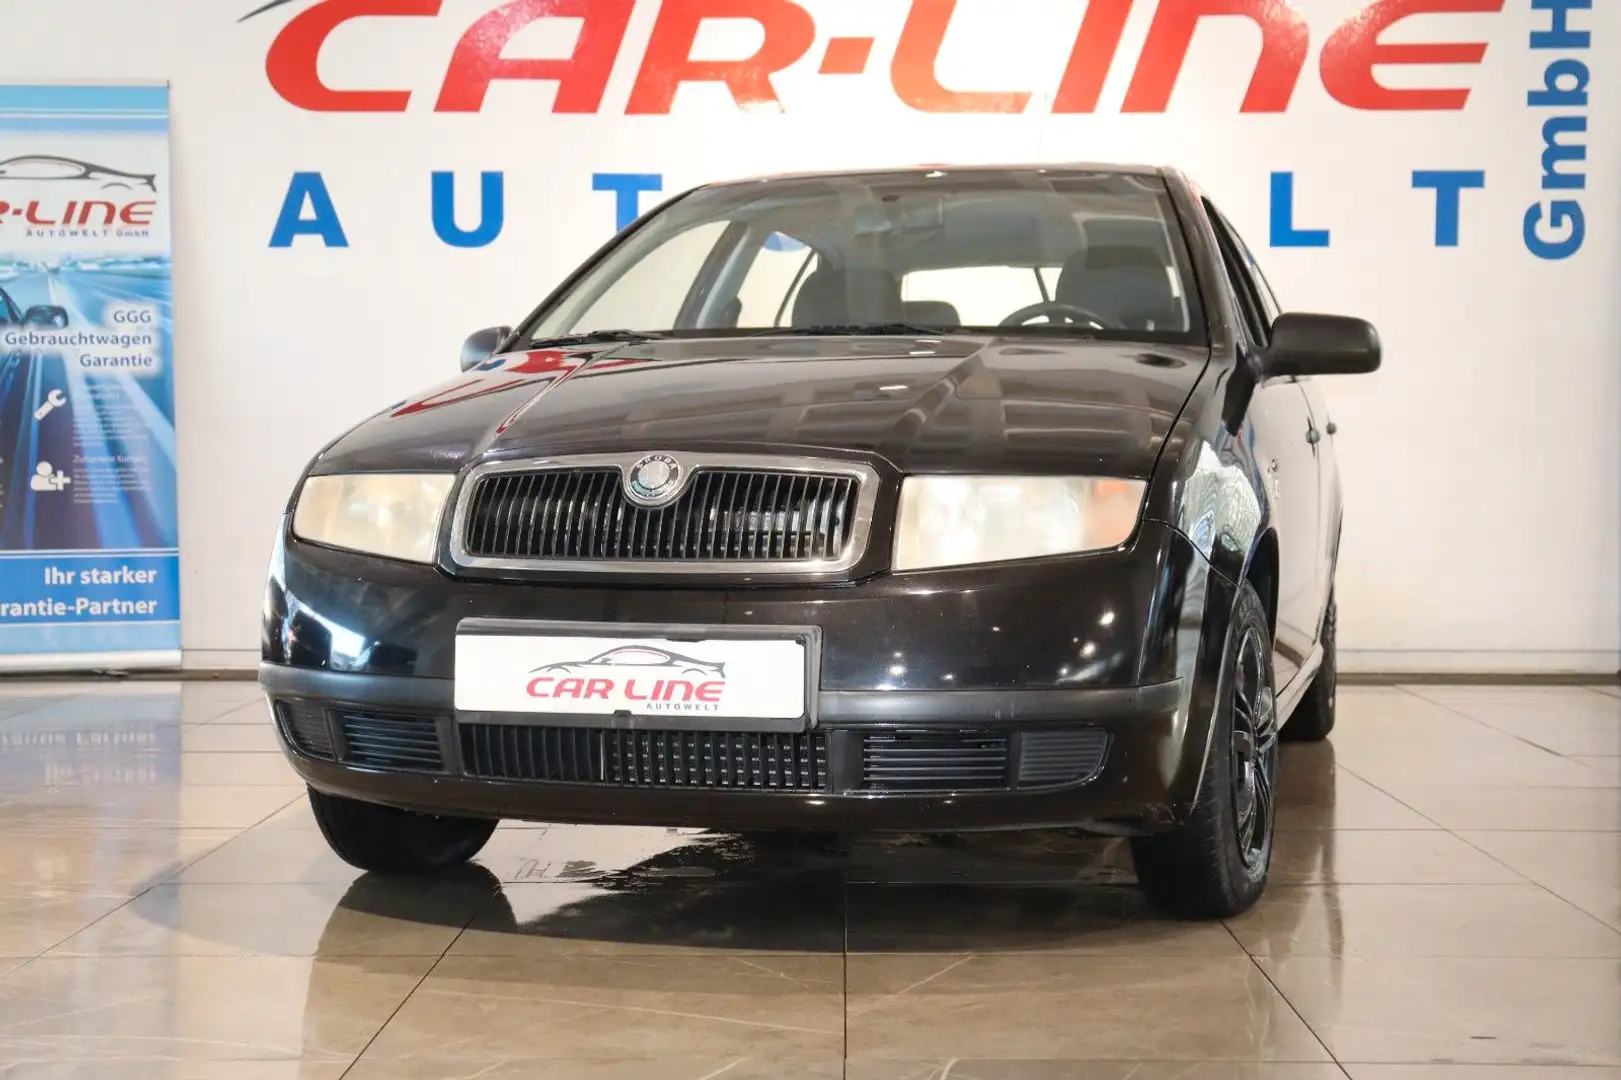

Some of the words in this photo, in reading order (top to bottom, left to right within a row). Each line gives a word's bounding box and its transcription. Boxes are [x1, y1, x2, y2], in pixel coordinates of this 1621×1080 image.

[1523, 0, 1593, 261] GmbH
[268, 170, 1486, 248] AUTLT
[26, 229, 109, 238] AUTOWELT
[113, 309, 152, 324] GGG
[4, 330, 152, 348] Gebrauchtwagen
[79, 353, 153, 367] Garantie
[44, 566, 76, 585] Ihr
[80, 565, 158, 585] starker
[0, 597, 158, 617] rantie-Partner
[526, 676, 615, 700] CAR
[624, 678, 726, 703] LINE
[645, 702, 719, 712] AUTOWELT
